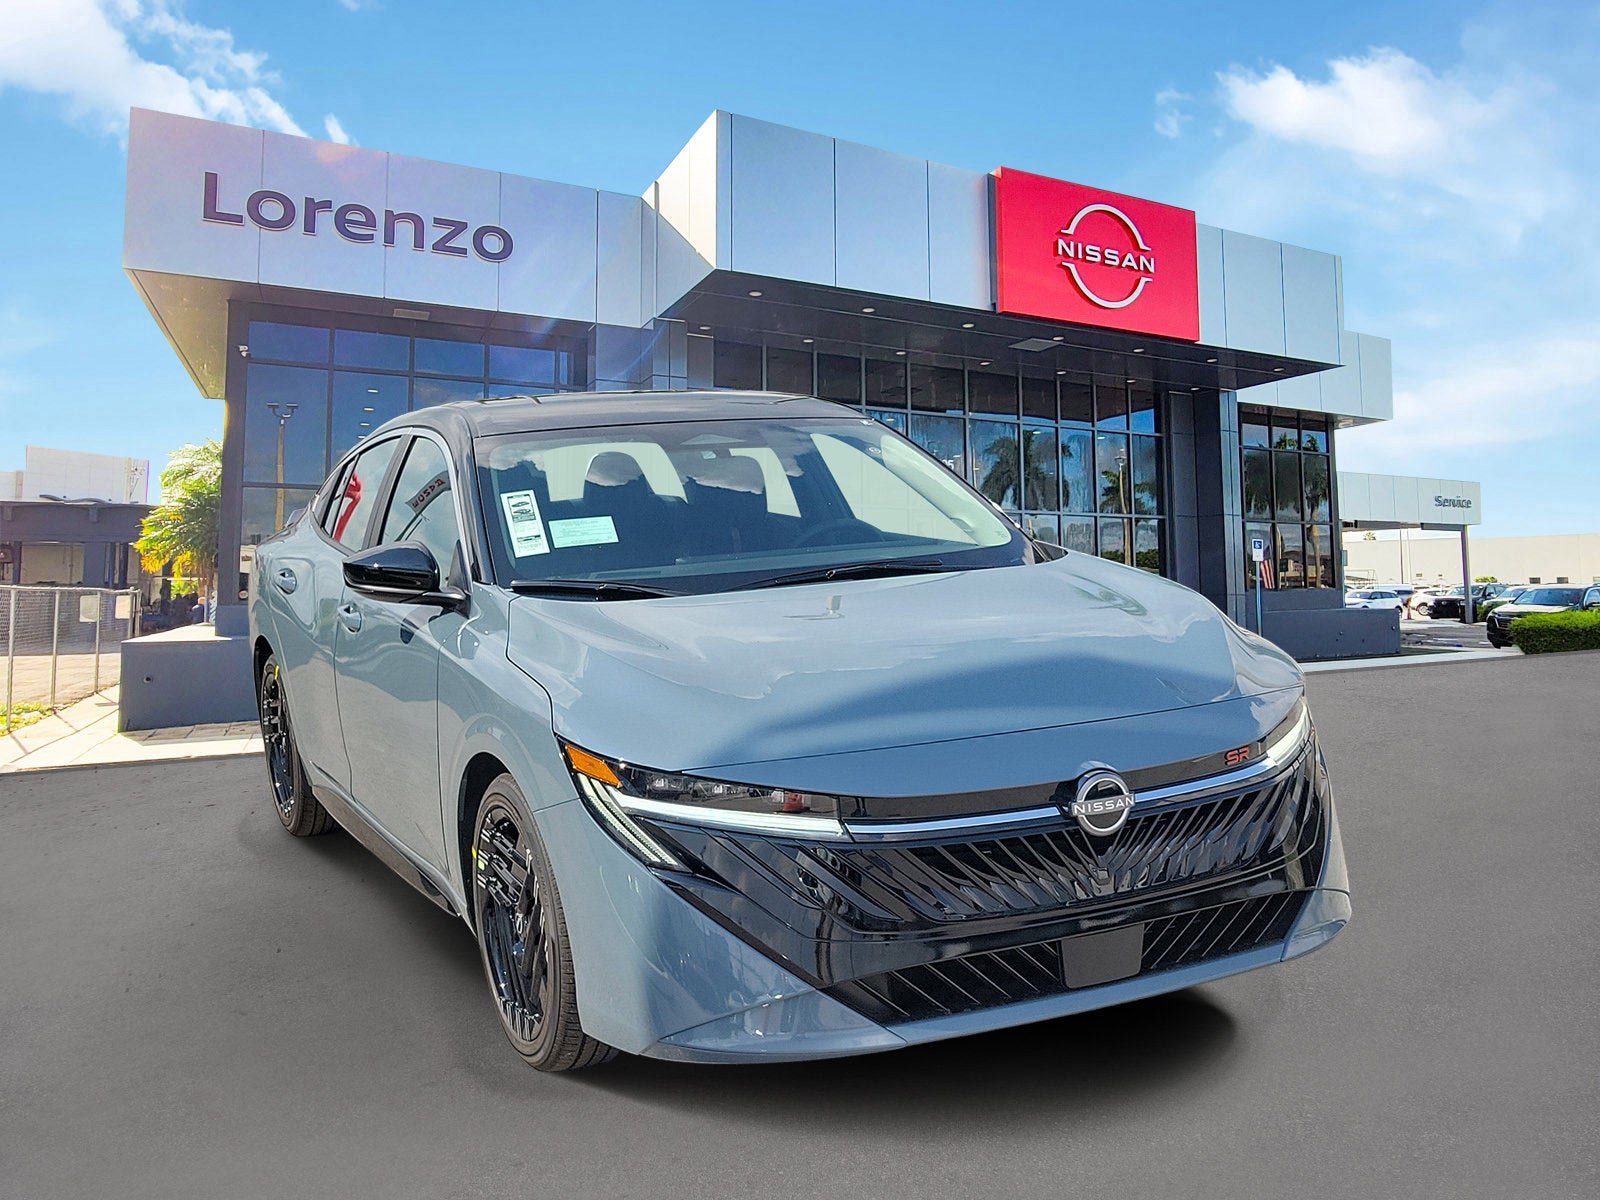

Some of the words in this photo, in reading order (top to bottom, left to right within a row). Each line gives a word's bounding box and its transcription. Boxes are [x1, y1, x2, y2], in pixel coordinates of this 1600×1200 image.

[202, 171, 514, 262] Lorenzo
[1057, 238, 1155, 273] NISSAN
[1434, 495, 1472, 509] Service
[1225, 747, 1250, 766] SR
[1074, 794, 1134, 815] NISSAN
